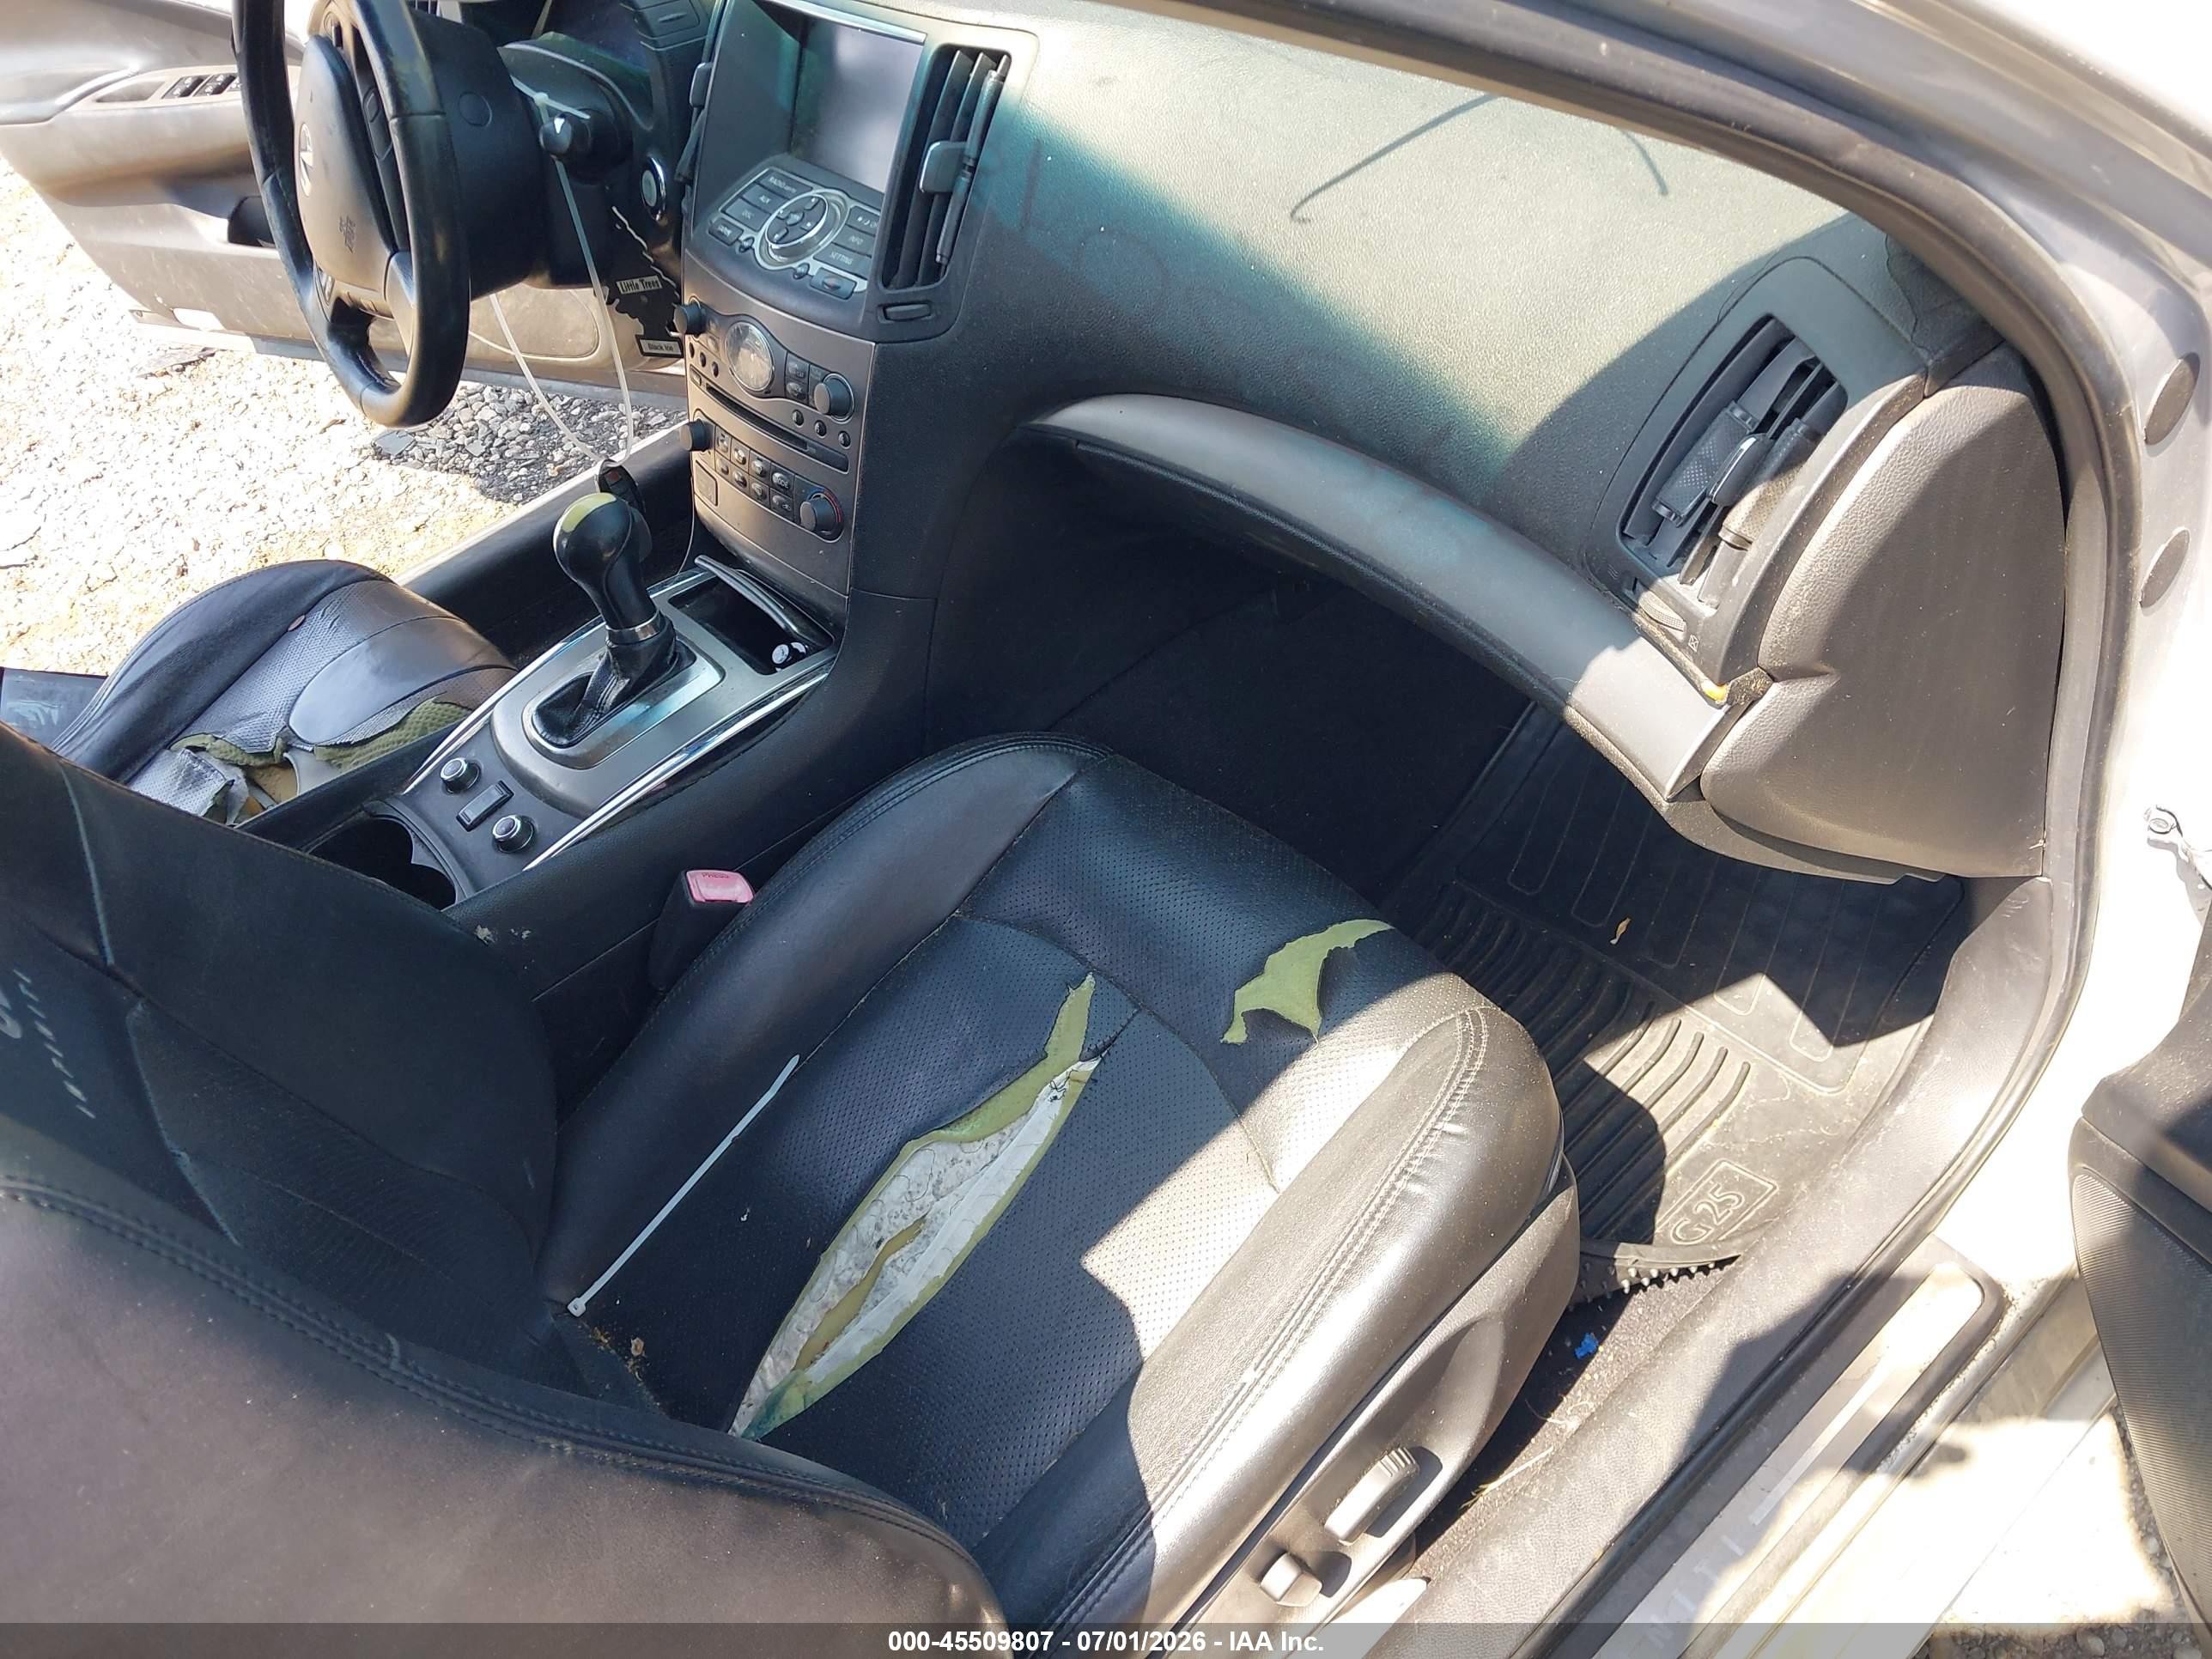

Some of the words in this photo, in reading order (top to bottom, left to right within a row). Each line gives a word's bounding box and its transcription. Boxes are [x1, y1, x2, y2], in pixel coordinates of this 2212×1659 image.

[619, 281, 639, 293] Little
[639, 278, 660, 290] Trees
[1670, 1182, 1745, 1246] G25
